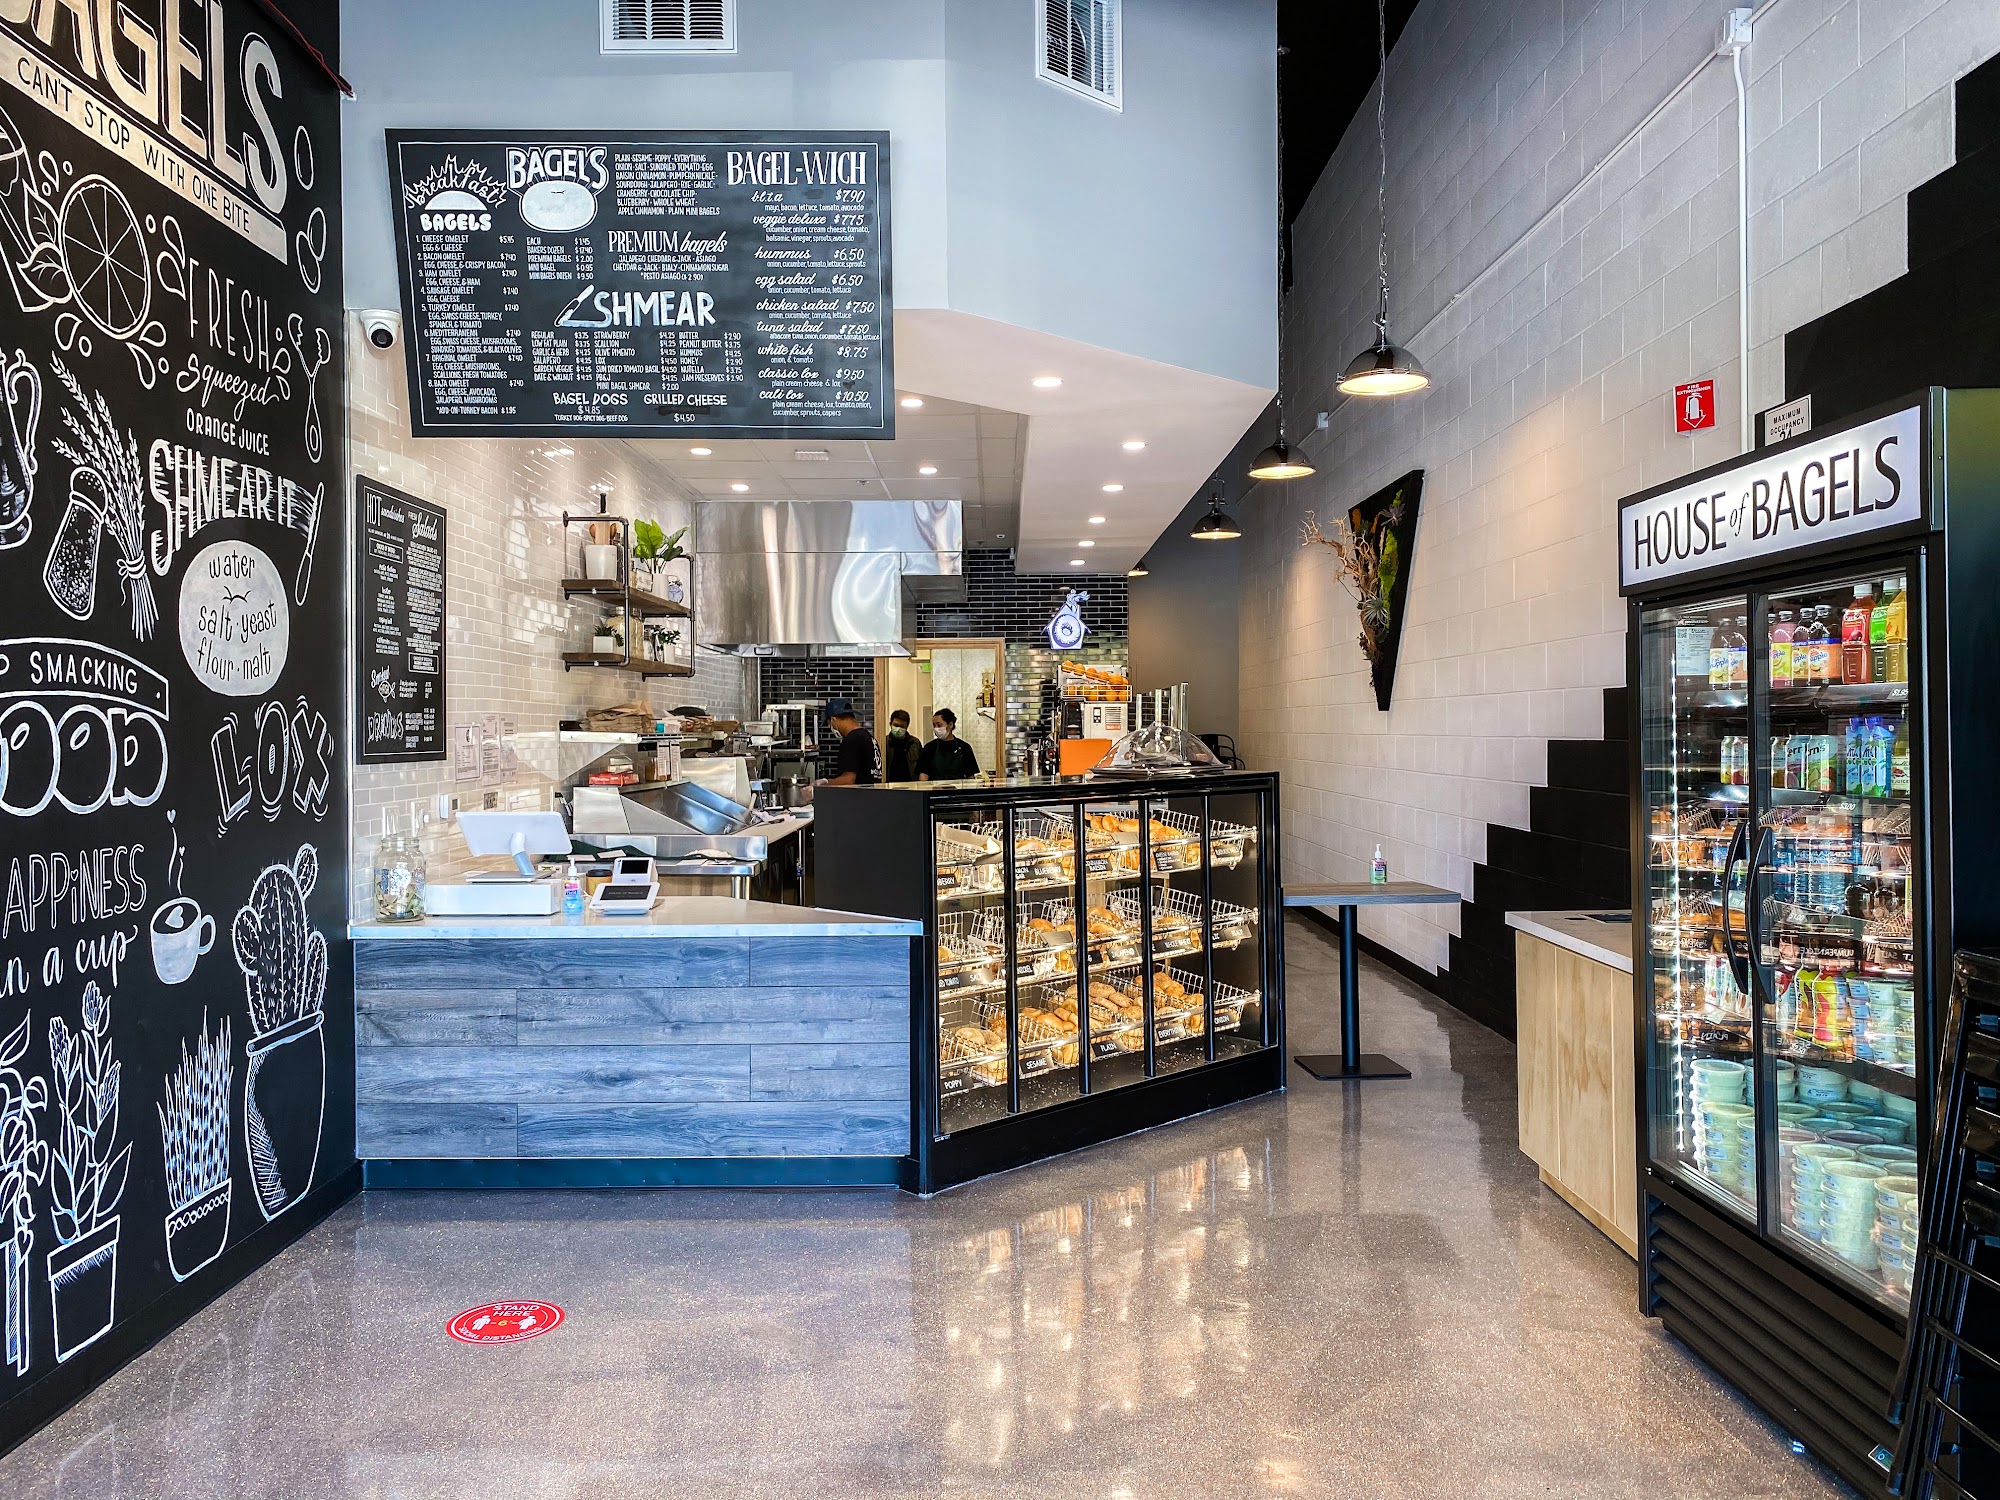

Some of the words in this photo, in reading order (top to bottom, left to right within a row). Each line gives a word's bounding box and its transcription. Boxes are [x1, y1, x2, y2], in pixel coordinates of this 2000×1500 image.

[84, 99, 131, 150] STOP
[142, 139, 186, 190] WITH
[192, 174, 218, 211] ONE
[223, 202, 250, 234] BITE
[507, 149, 607, 190] BAGELS
[727, 150, 867, 186] BAGEL-WICH
[836, 188, 866, 204] $7.90
[420, 213, 492, 231] BAGELS
[752, 213, 787, 228] veggie
[788, 213, 827, 225] deluxe
[608, 230, 678, 253] PREMIUM
[680, 230, 728, 256] bagels
[754, 246, 812, 260] hummus
[834, 248, 864, 261] $6.50
[755, 275, 777, 289] egg
[778, 272, 816, 285] salad
[832, 274, 864, 286] $6.50
[190, 257, 270, 373] FRESH
[590, 290, 716, 328] SHMEAR
[756, 298, 800, 310] chicken
[801, 298, 840, 310] salad
[846, 300, 875, 314] $7.50
[756, 320, 786, 332] tuna
[788, 320, 824, 332] salad
[758, 343, 788, 356] white
[789, 343, 814, 356] fish
[837, 346, 869, 358] $8.75
[176, 353, 280, 421] Squeezed
[758, 367, 800, 379] classic
[800, 367, 820, 379] lox
[836, 368, 865, 380] $9.50
[553, 392, 590, 405] BAGEL
[592, 394, 628, 406] DOGS
[644, 394, 684, 405] GRILLED
[686, 394, 728, 406] CHEESE
[786, 390, 804, 400] lox
[836, 390, 869, 402] $10.50
[1770, 416, 1805, 436] OCCUPANCY
[1773, 408, 1801, 424] MAXIMUM
[186, 407, 237, 447] ORANGE
[238, 424, 271, 456] JUICE
[150, 438, 275, 577] SHMEAR
[366, 492, 382, 526] HOT
[1634, 490, 1727, 570] HOUSE
[1729, 491, 1750, 538] of
[1752, 435, 1902, 542] BAGELS
[412, 512, 438, 541] Salads
[208, 549, 256, 579] water
[198, 604, 234, 642] salt
[239, 599, 279, 644] yeast
[197, 635, 236, 682] flour
[242, 642, 272, 681] malt
[30, 650, 139, 695] SMACKING
[211, 700, 332, 823] LOX
[42, 946, 64, 987] a
[75, 925, 139, 988] cup
[1026, 1058, 1048, 1070] SESAME
[944, 1079, 962, 1090] POPPY
